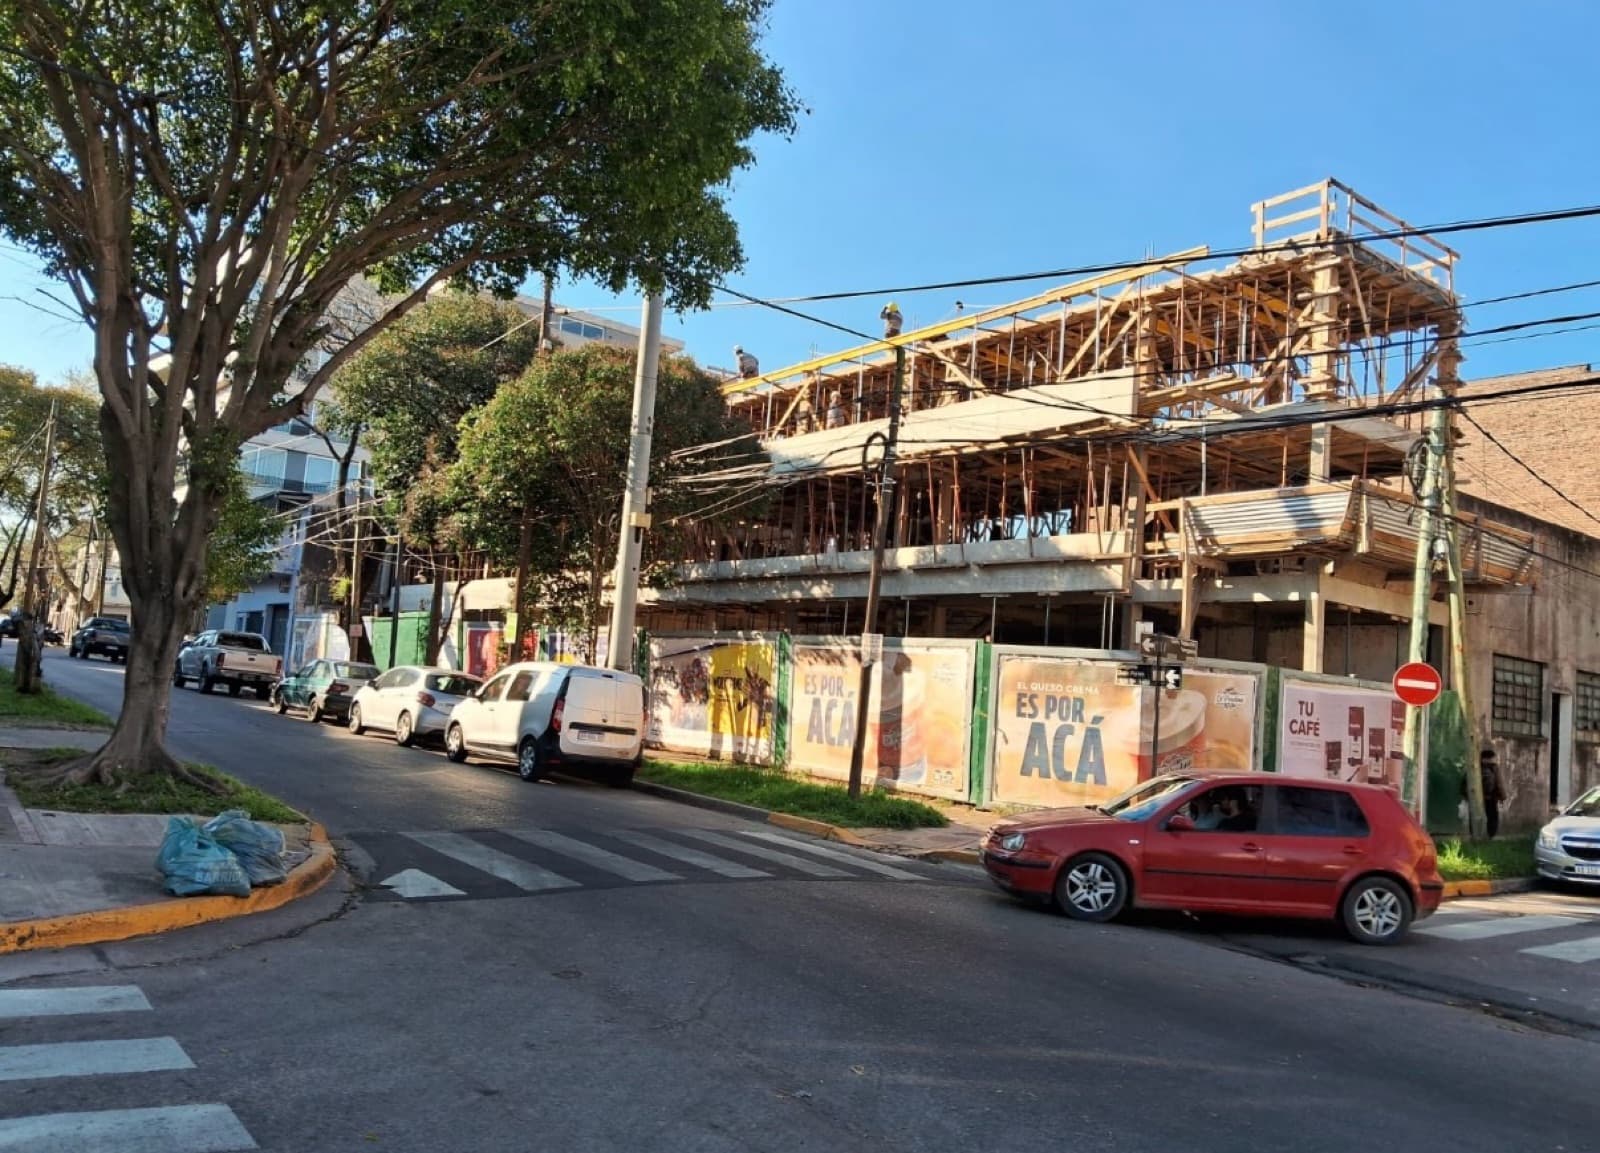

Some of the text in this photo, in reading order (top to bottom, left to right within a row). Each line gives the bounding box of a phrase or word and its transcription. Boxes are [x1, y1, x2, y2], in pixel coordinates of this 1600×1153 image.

[804, 673, 844, 697] ES POR
[807, 690, 857, 747] ACÁ
[1016, 692, 1085, 724] ES POR
[1298, 700, 1314, 716] TU
[1289, 717, 1320, 737] CAFÉ
[1020, 715, 1107, 786] ACÁ
